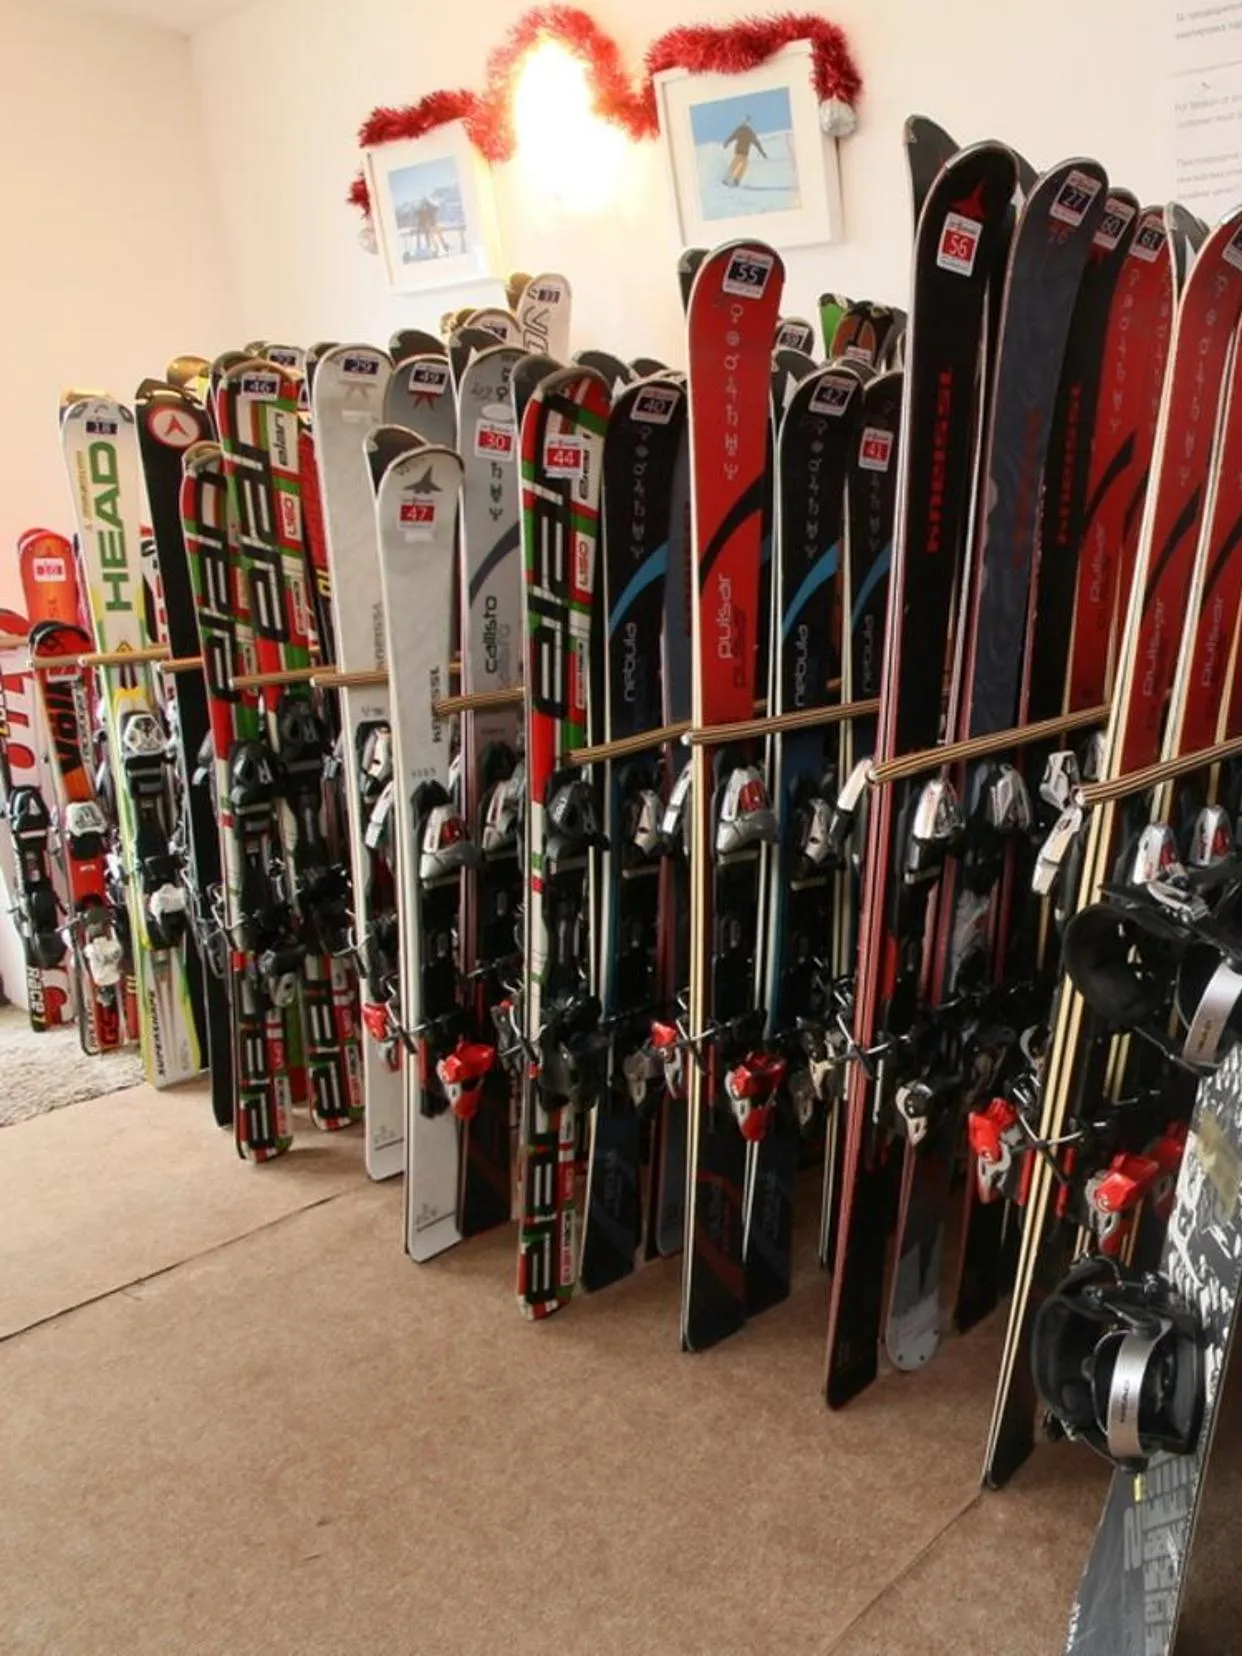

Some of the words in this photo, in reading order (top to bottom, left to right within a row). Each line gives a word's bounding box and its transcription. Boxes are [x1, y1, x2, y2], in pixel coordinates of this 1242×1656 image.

[1064, 192, 1084, 207] 27
[950, 236, 968, 258] 56
[737, 264, 758, 282] 55
[822, 388, 843, 405] 42
[553, 452, 575, 465] 44
[866, 444, 883, 460] 41
[89, 440, 133, 613] HEAD
[406, 505, 428, 520] 47
[484, 595, 498, 674] callisto
[717, 572, 733, 660] pulsar
[624, 621, 638, 702] nebula
[794, 623, 809, 707] nebula
[863, 613, 875, 692] nebula
[149, 990, 167, 1076] SUPERSHAPE
